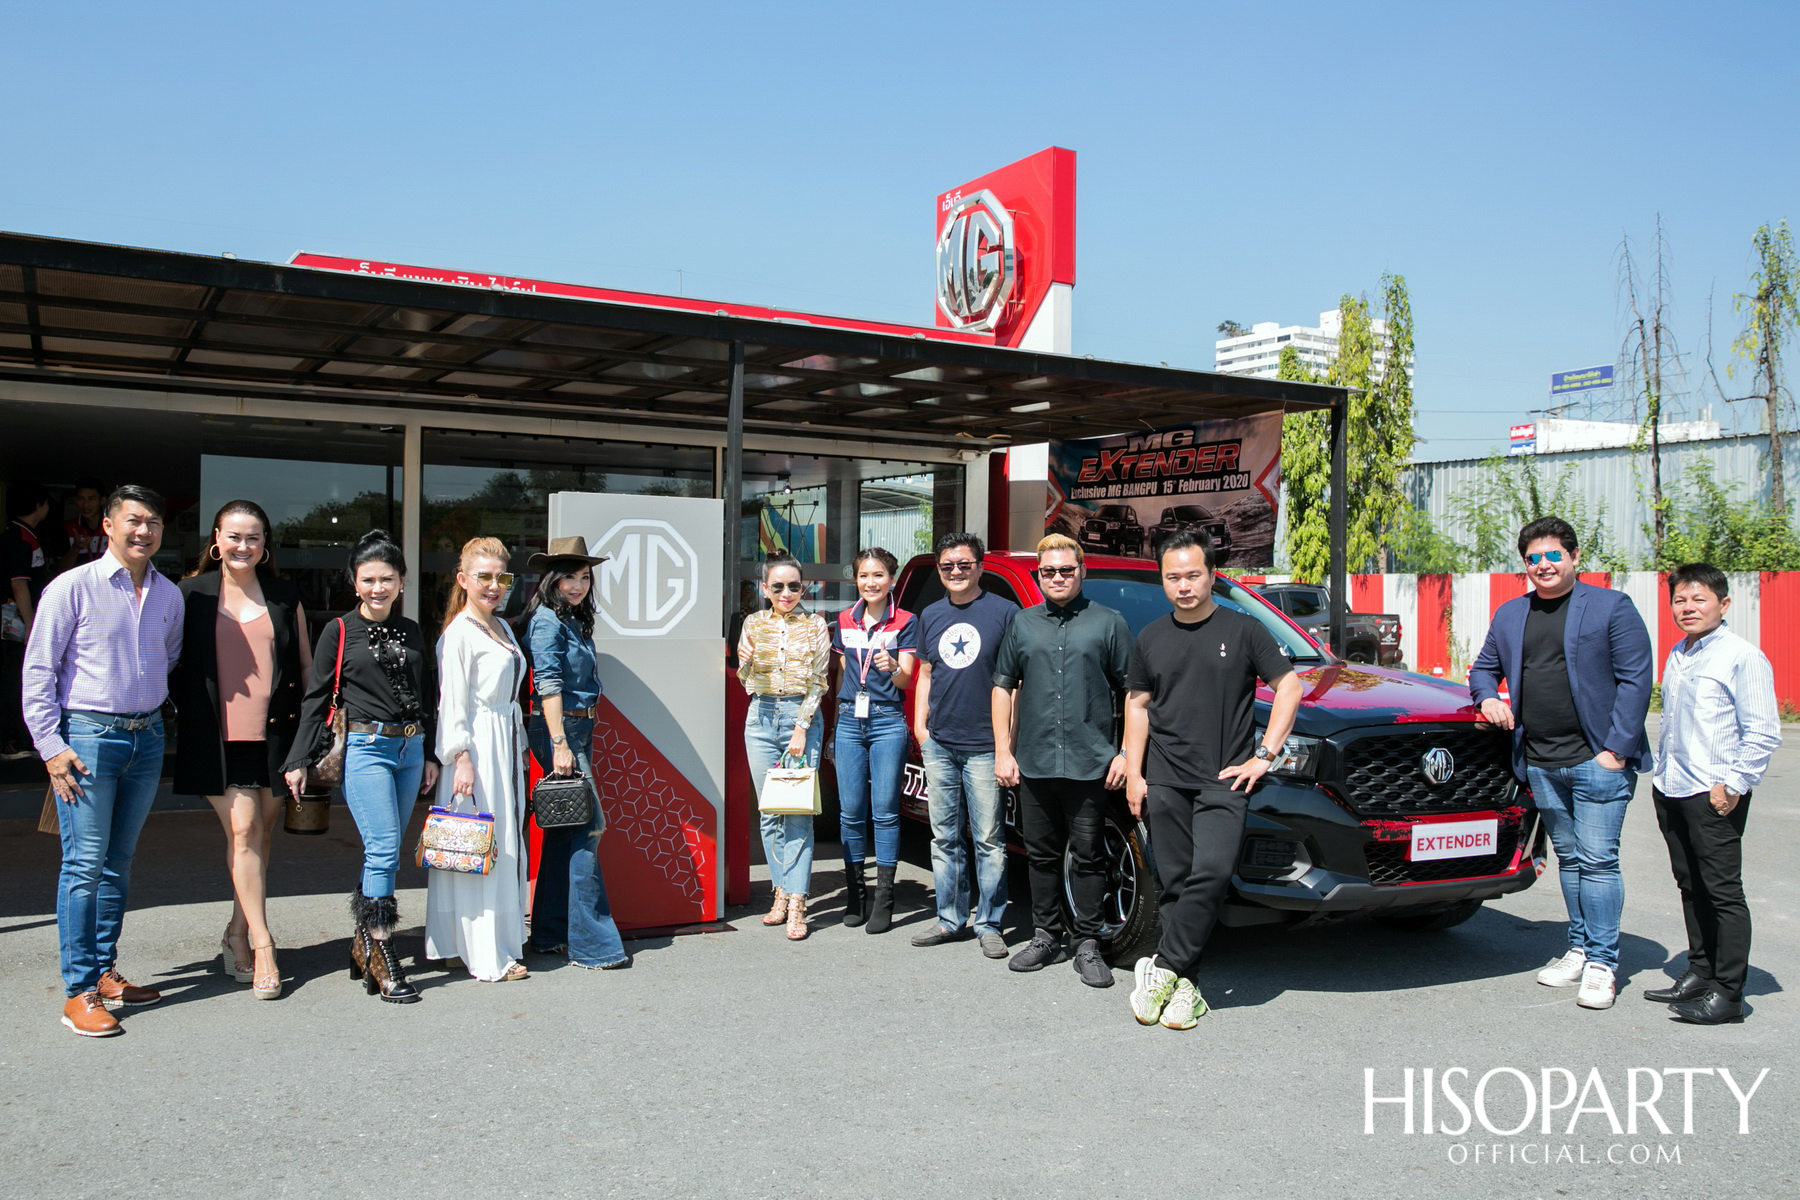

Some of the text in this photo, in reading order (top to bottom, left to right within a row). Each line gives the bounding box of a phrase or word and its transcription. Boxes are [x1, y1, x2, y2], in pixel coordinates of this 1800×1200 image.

[938, 208, 1001, 318] MG
[1128, 430, 1194, 452] MG
[1078, 443, 1241, 482] EXTENDER
[1107, 484, 1122, 498] MG
[1122, 481, 1158, 497] BANGPU
[1178, 478, 1222, 493] February
[1222, 473, 1249, 490] 2020
[1417, 833, 1491, 852] EXTENDER
